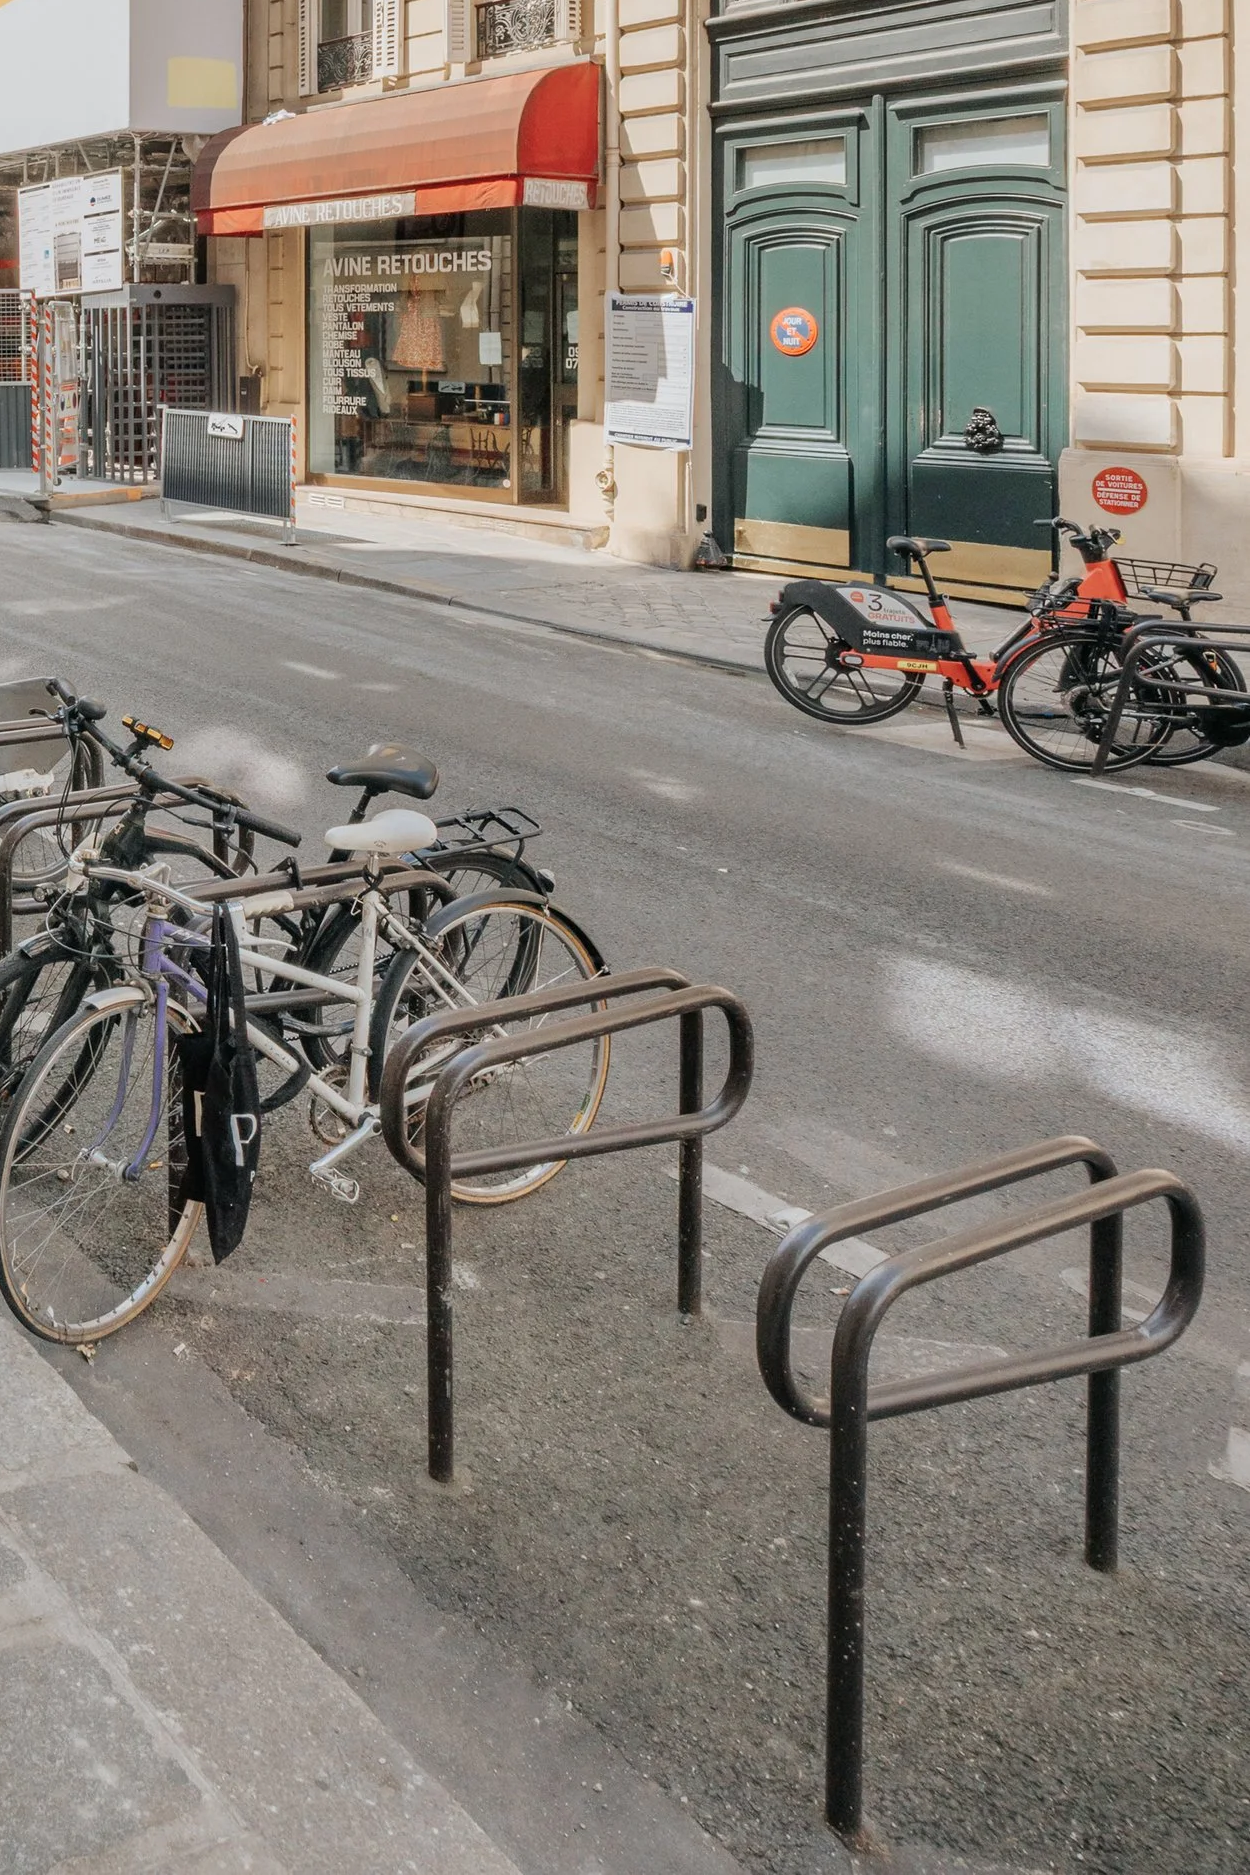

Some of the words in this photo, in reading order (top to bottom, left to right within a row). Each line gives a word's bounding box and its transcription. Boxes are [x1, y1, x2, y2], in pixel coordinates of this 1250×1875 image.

[525, 178, 585, 206] RETOUCHES
[274, 202, 310, 226] AVINE
[316, 194, 402, 222] RETOUCHES
[323, 255, 372, 277] AVINE
[377, 250, 492, 275] RETOUCHES
[323, 283, 397, 294] TRANSFORMATION
[322, 293, 371, 303] RETOUCHES
[323, 303, 344, 313] TOUS
[346, 302, 395, 312] VETEMENTS
[323, 313, 348, 322] VESTE
[783, 317, 802, 326] JOUR
[322, 322, 364, 331] PANTALON
[786, 327, 797, 336] ET
[322, 331, 357, 341] CHEMISE
[322, 340, 344, 350] ROBE
[782, 337, 801, 346] NUIT
[323, 349, 361, 358] MANTEAU
[322, 358, 362, 368] BLOUSON
[323, 368, 344, 377] TOUS
[346, 368, 376, 377] TISSUS
[322, 377, 342, 386] CUIR
[322, 386, 342, 395] DAIM
[322, 396, 367, 406] FOURRURE
[322, 405, 358, 415] RIDEAUX
[1104, 474, 1133, 482] SORTIE
[1107, 481, 1143, 490] VOITURES
[1131, 494, 1141, 502] DE
[1098, 498, 1139, 509] STATIONNER
[867, 593, 883, 612] 3
[867, 611, 916, 624] GRATUITS
[862, 630, 890, 639] Moins
[862, 637, 882, 646] plus
[882, 638, 909, 648] fiable.
